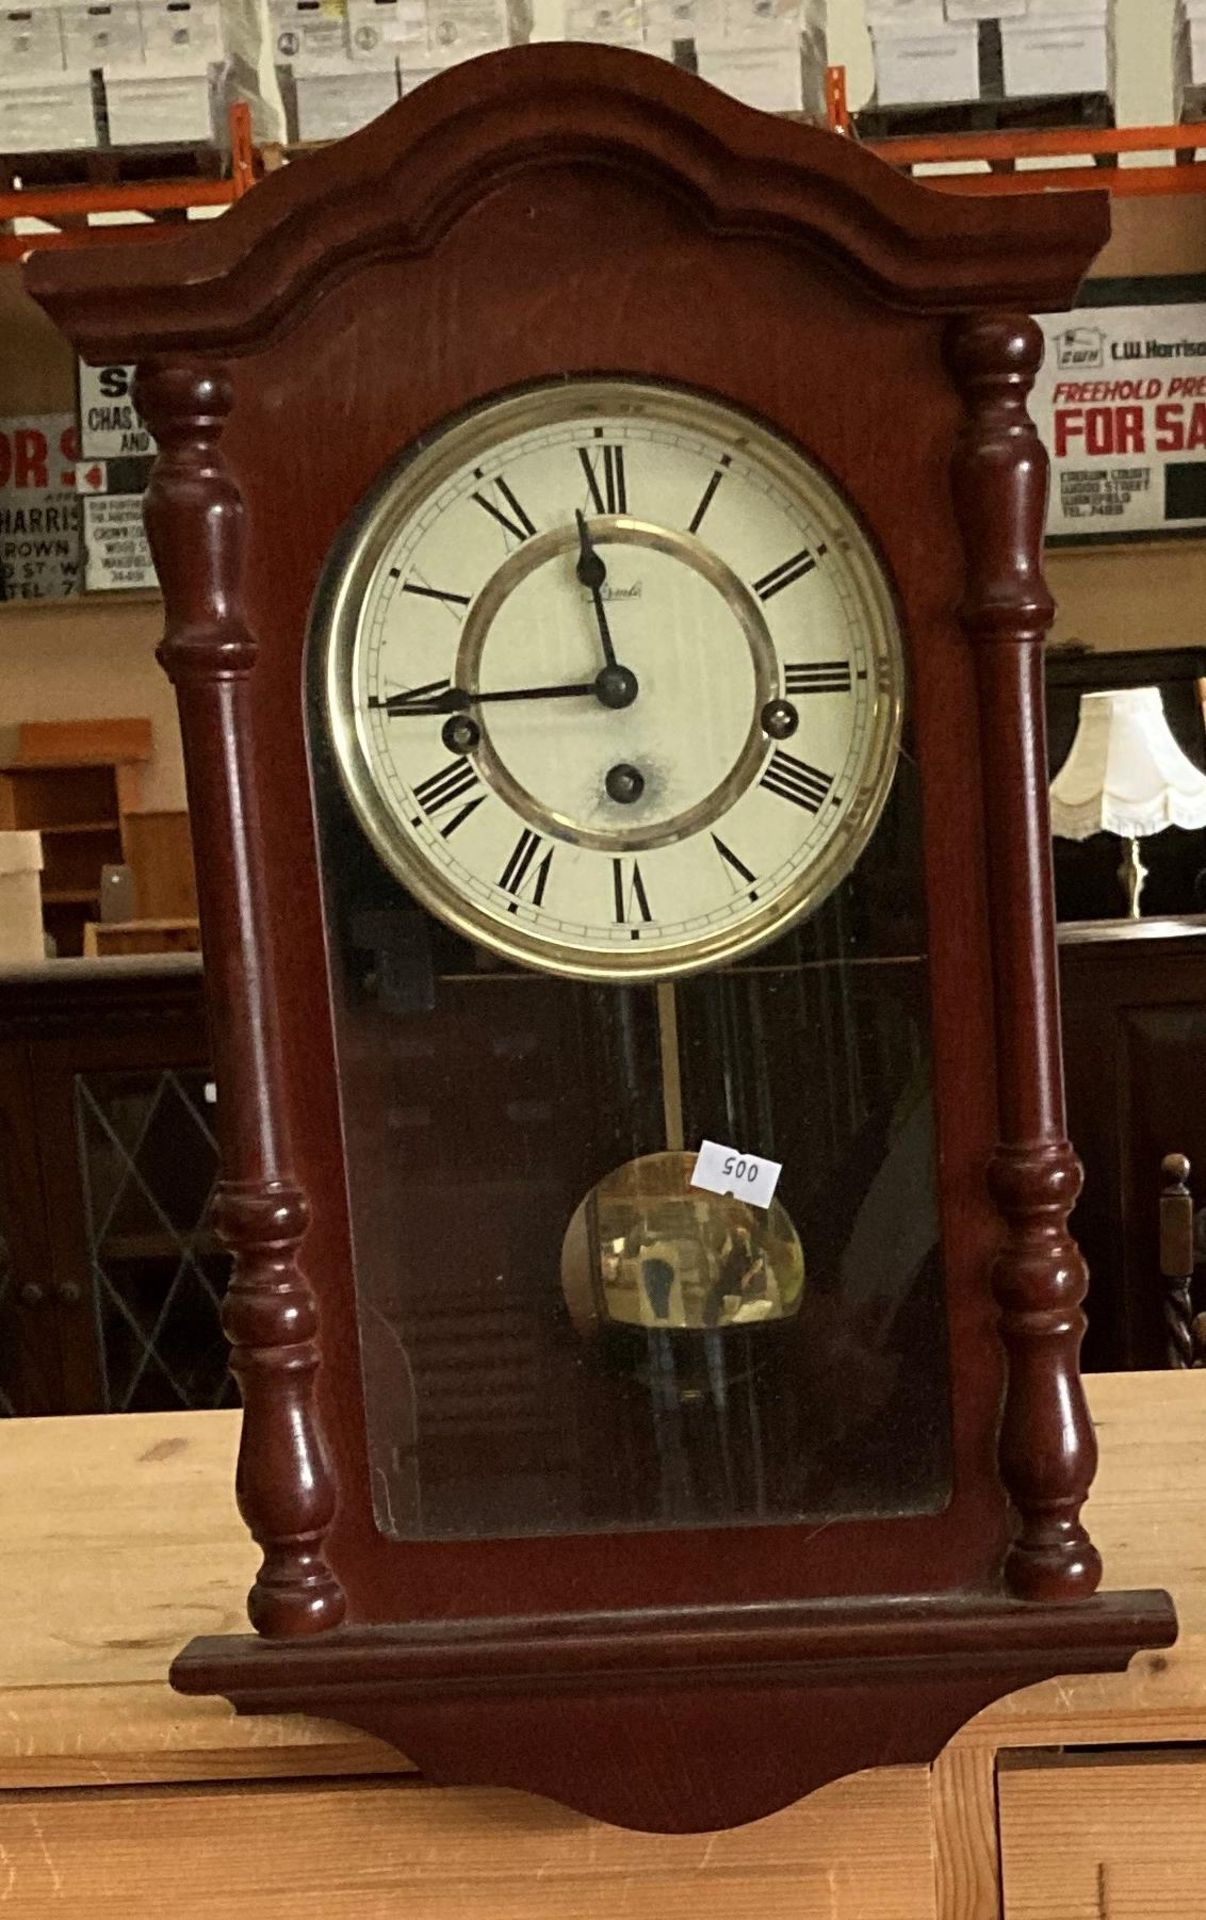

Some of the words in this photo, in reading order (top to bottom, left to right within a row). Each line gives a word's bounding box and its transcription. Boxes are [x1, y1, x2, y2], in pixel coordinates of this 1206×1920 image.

[1053, 379, 1161, 403] FREEHOLD
[88, 406, 132, 431] CHAS
[1055, 406, 1144, 457] FOR
[578, 444, 628, 515] XII
[784, 660, 851, 694] III
